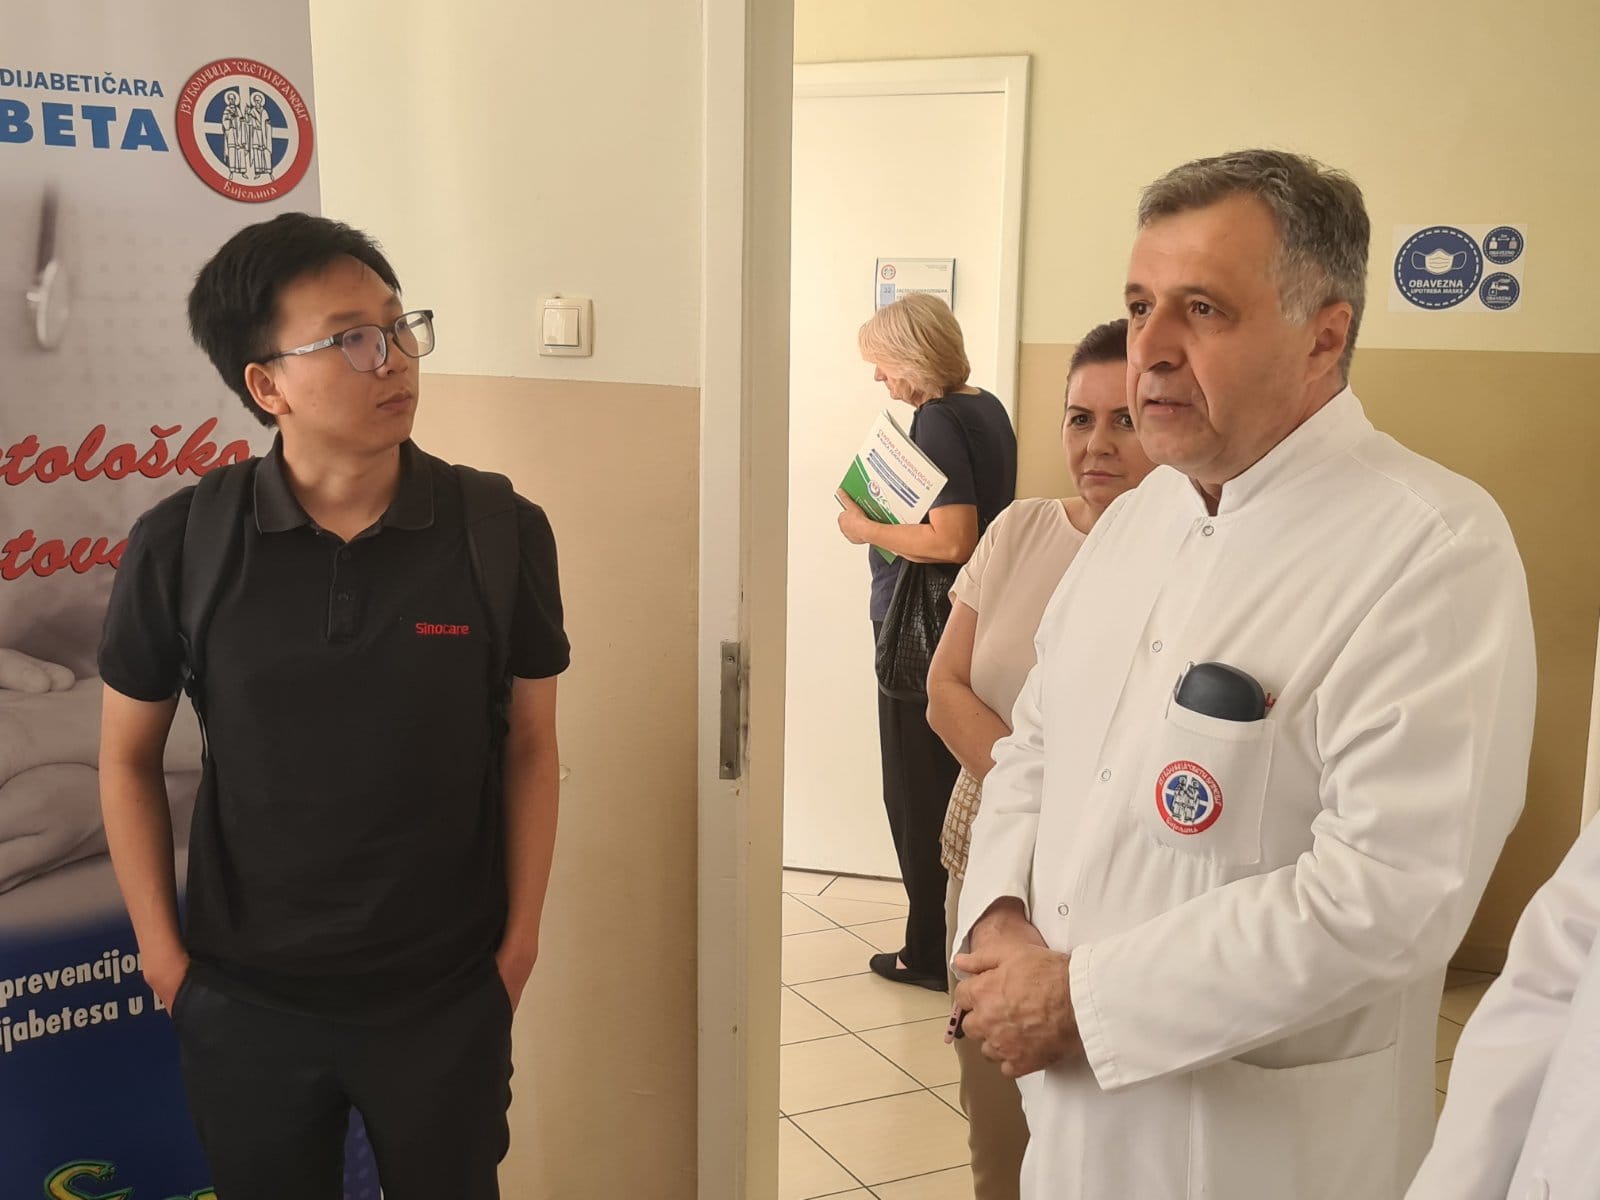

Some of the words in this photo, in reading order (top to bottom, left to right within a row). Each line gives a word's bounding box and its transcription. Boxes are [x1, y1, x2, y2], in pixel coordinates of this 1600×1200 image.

[0, 68, 164, 98] DIJABETIČARA
[0, 98, 169, 152] BETA
[1408, 279, 1464, 288] OBAVEZNA
[0, 417, 251, 486] tološko
[415, 622, 470, 635] Sinocare
[128, 996, 144, 1016] u
